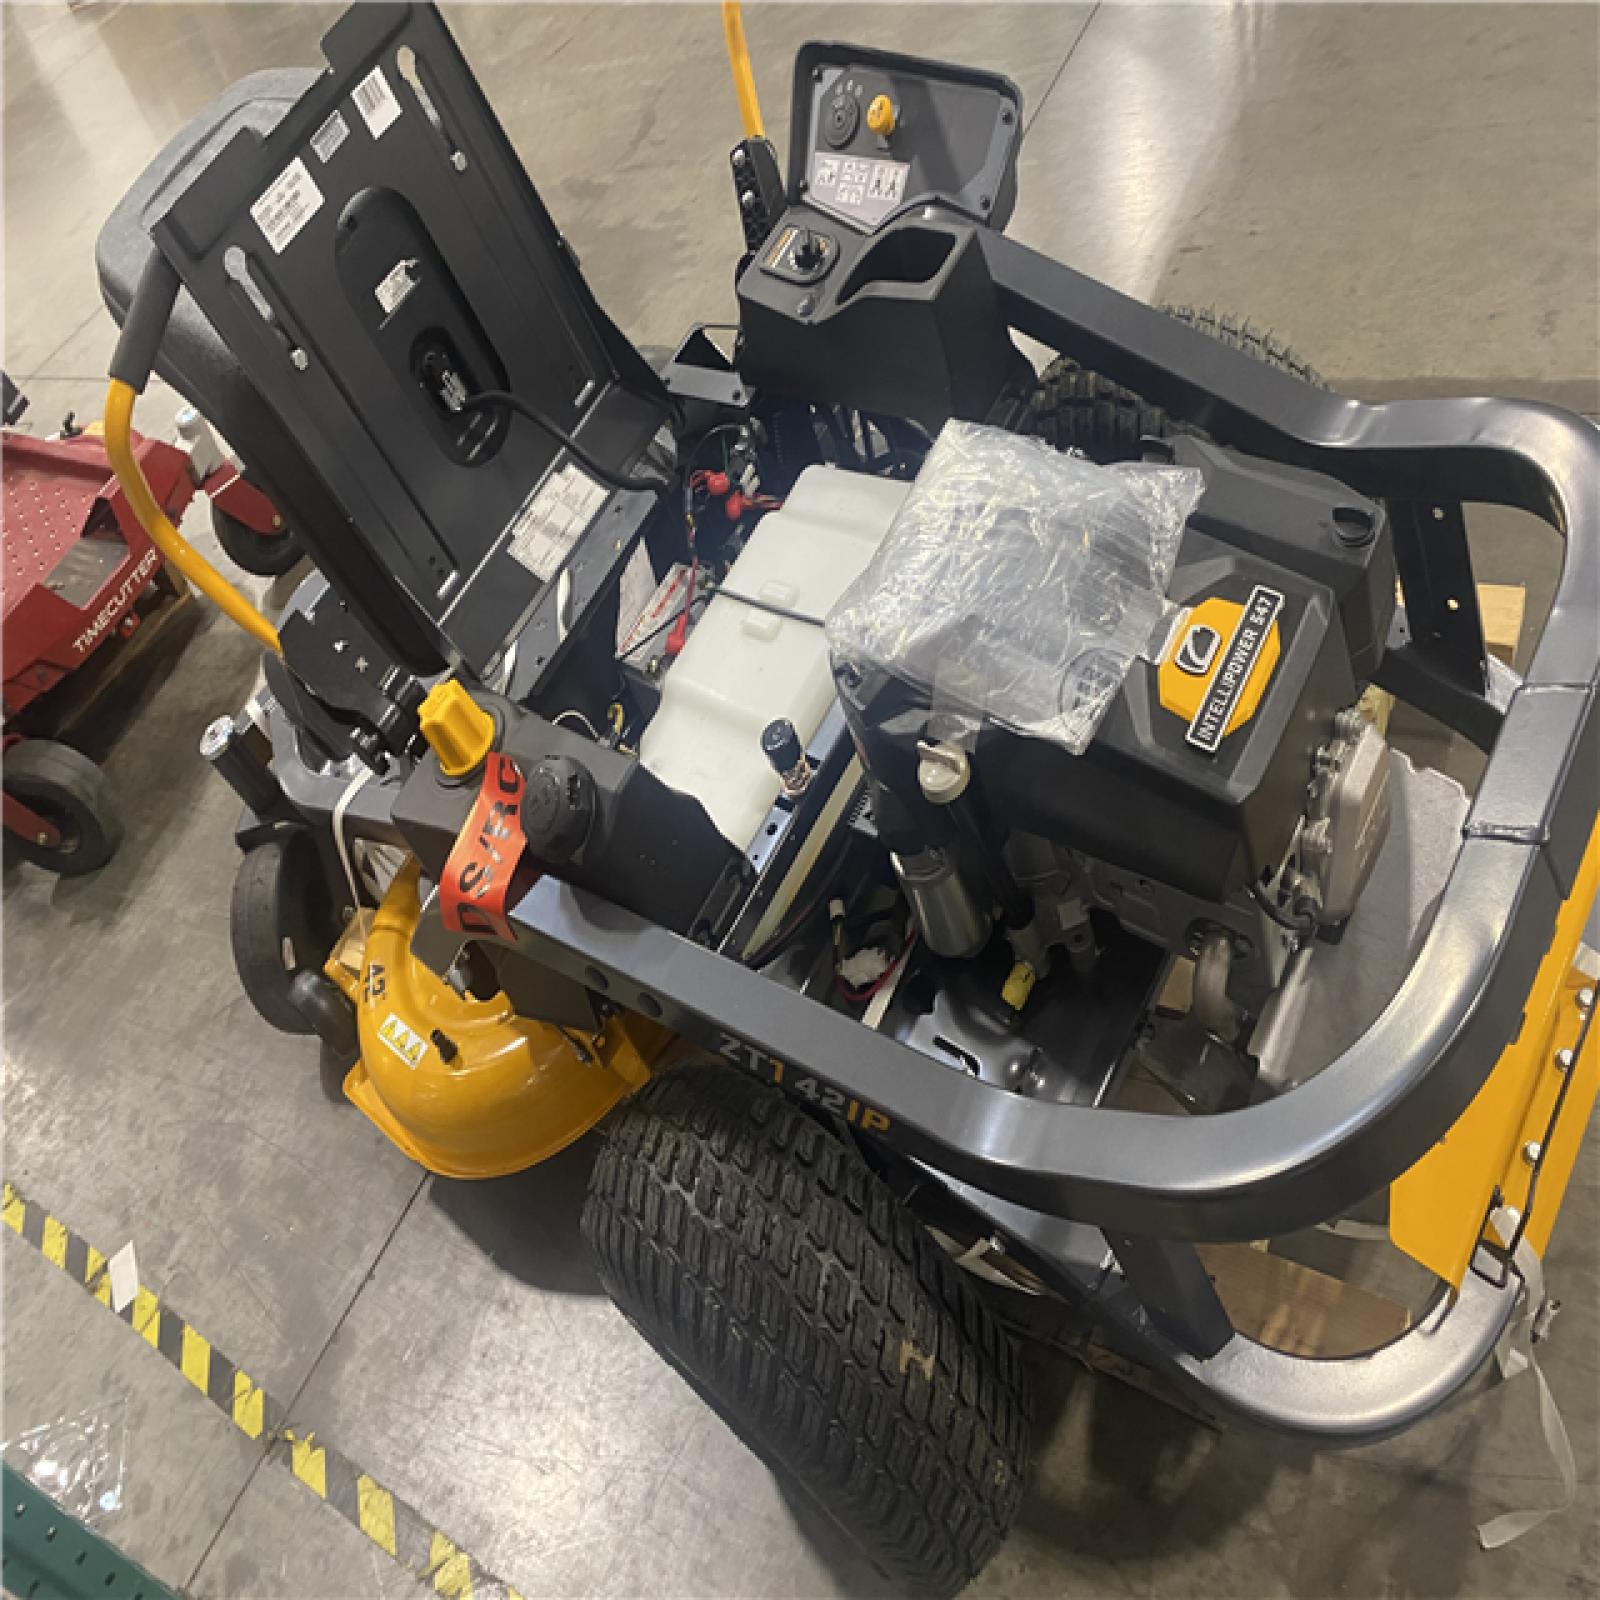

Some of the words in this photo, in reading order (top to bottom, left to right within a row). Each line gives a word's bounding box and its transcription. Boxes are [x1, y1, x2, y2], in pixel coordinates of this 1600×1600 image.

[72, 546, 157, 653] TIMECUTTER
[1197, 629, 1259, 741] INTELLIPOWER
[719, 1032, 784, 1084] ZT1
